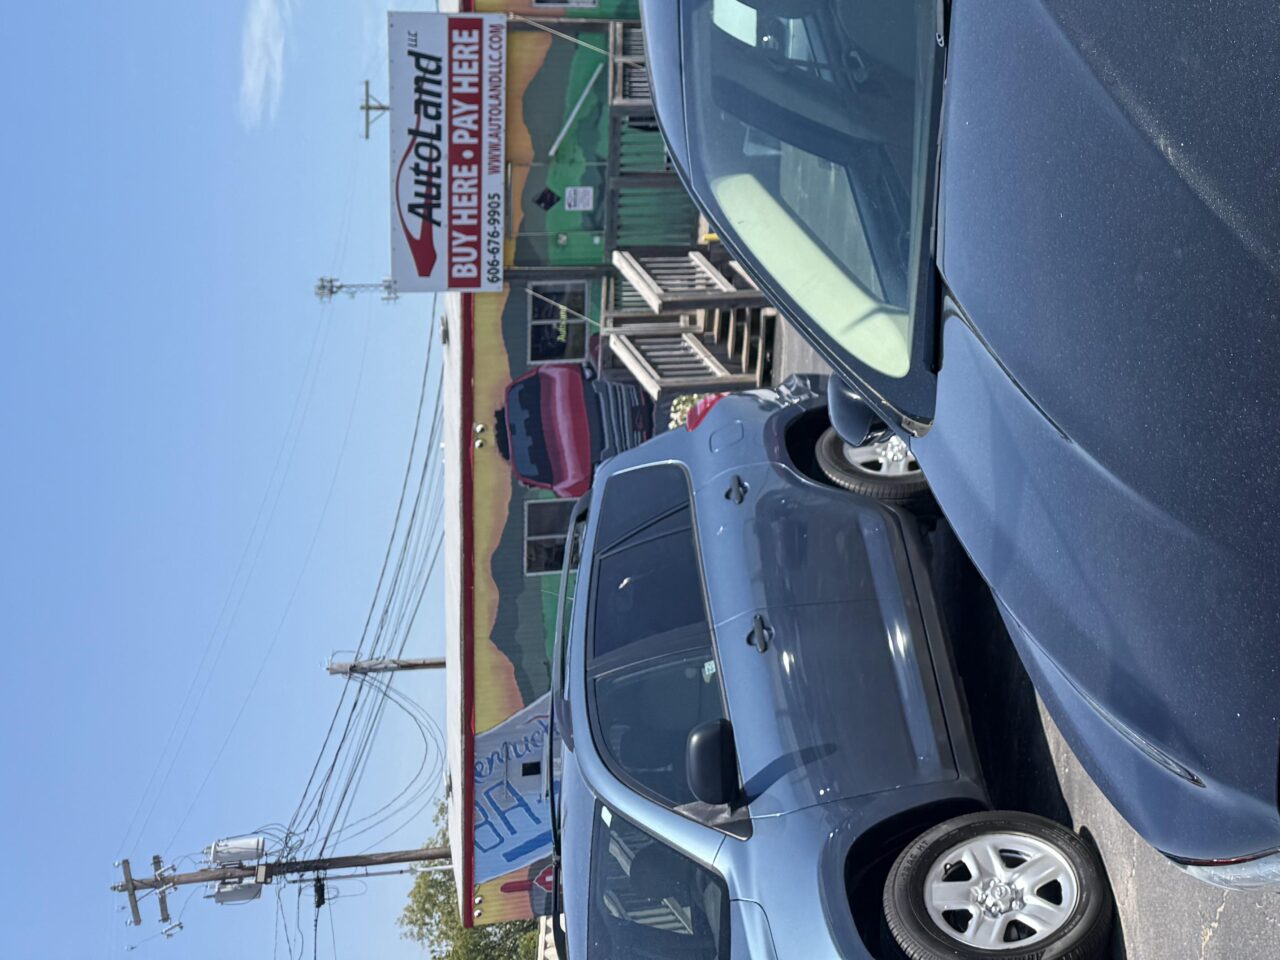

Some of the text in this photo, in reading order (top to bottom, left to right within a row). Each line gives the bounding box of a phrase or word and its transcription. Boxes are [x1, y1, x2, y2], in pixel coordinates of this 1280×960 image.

[407, 29, 442, 227] AutoLand LLC
[451, 28, 480, 278] BUY HERE PAY HERE
[487, 23, 505, 175] WWW.AUTOLANDLLC.COM
[487, 192, 502, 284] 606-676-9905
